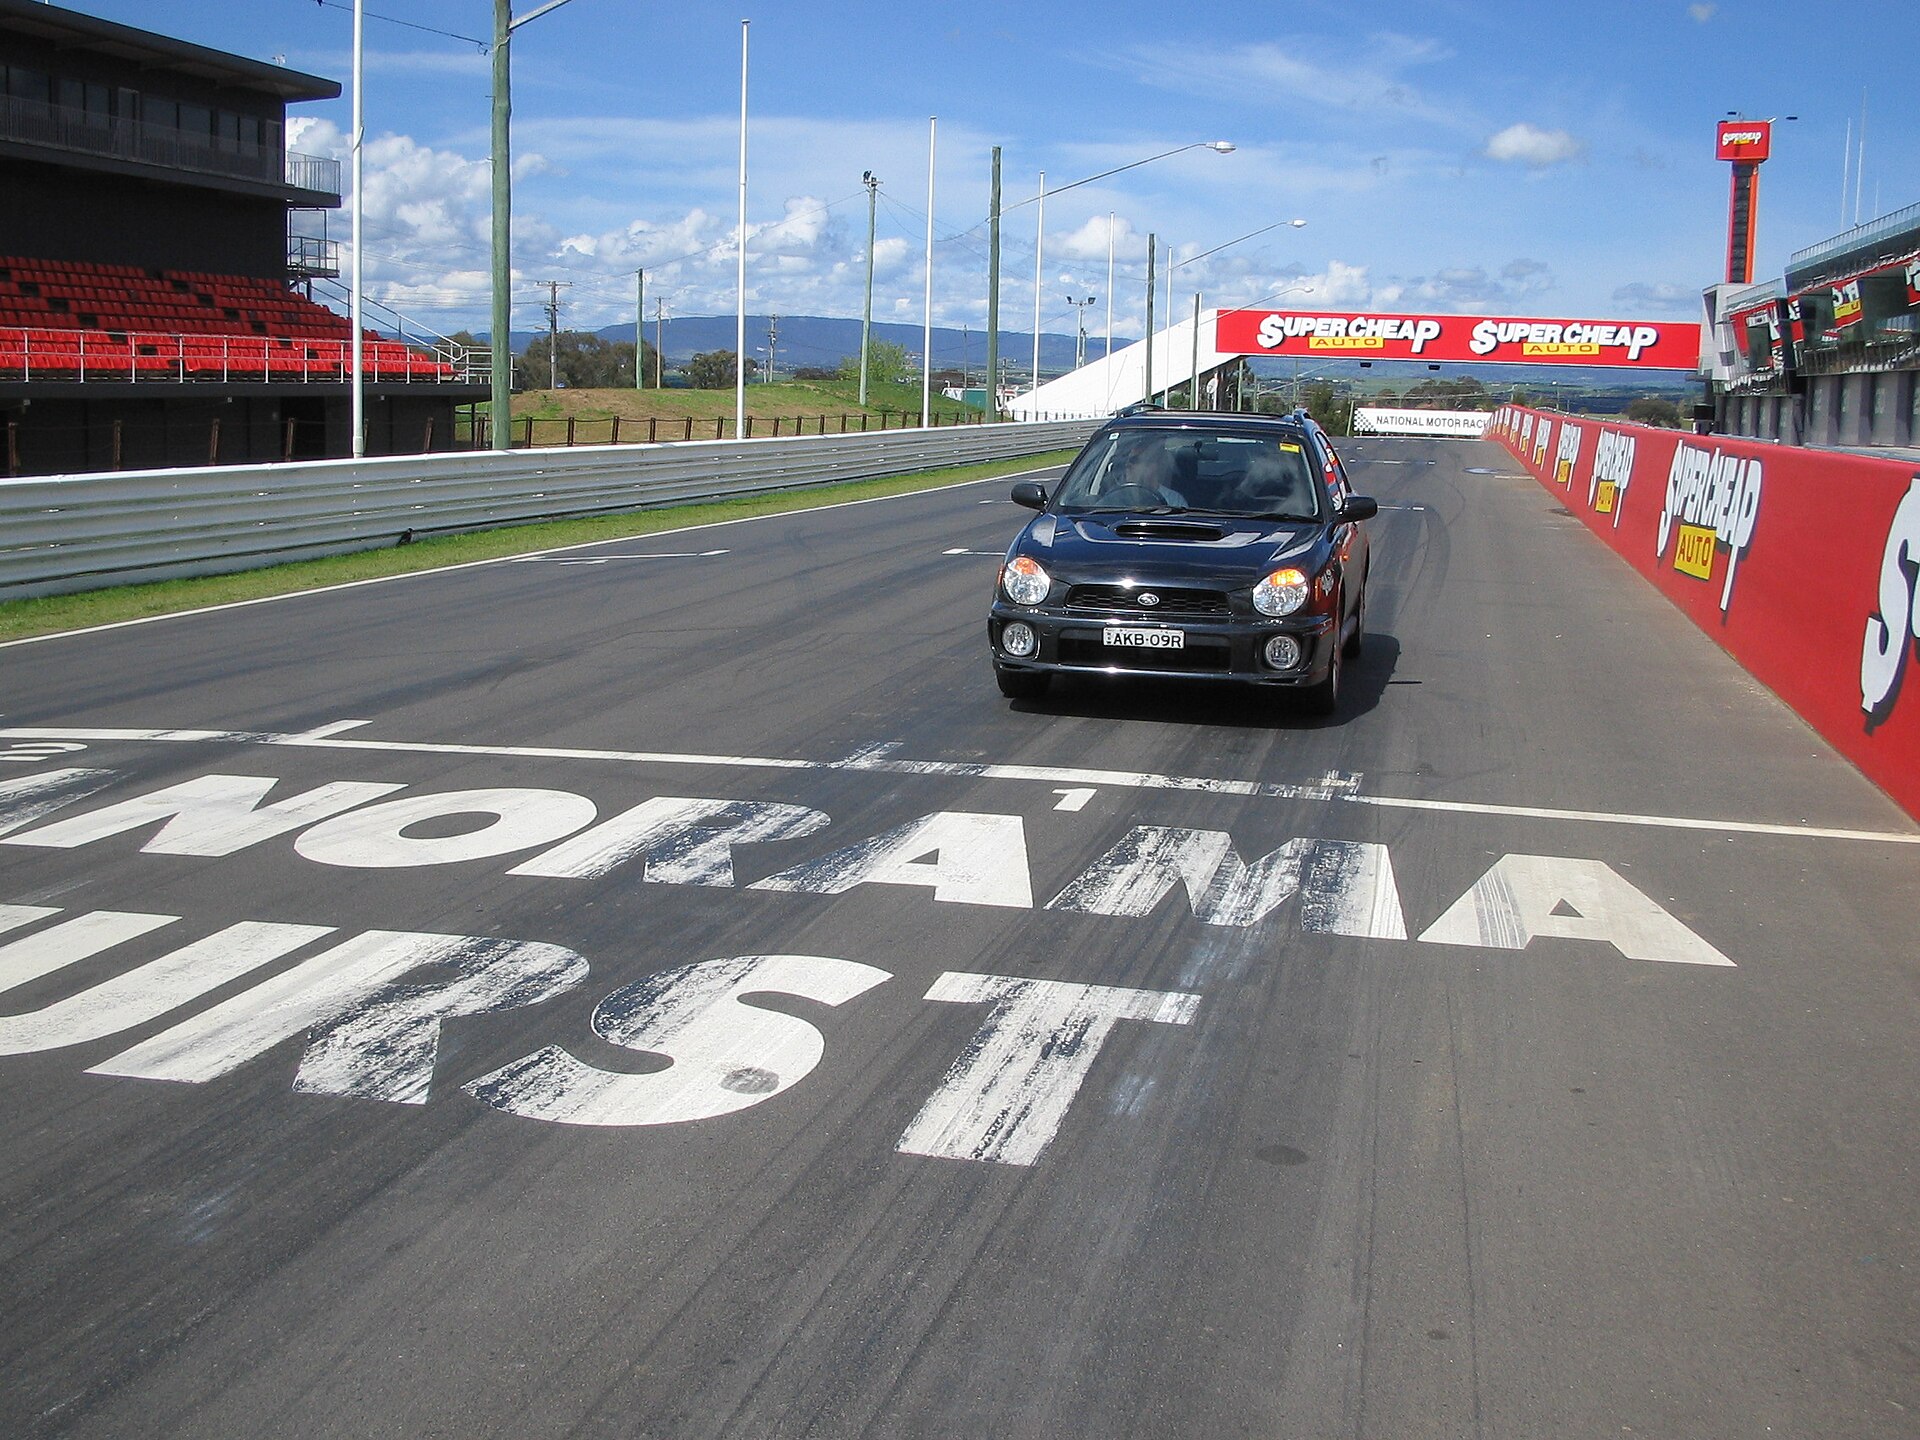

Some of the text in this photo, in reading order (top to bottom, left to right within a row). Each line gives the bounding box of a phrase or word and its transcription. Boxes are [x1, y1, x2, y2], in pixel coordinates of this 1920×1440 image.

[1315, 338, 1378, 347] AUTO
[1529, 344, 1593, 353] AUTO
[1376, 416, 1424, 426] NATIONAL
[1426, 417, 1461, 428] MOTOR
[1677, 534, 1712, 567] AUTO
[0, 904, 1201, 1167] URST
